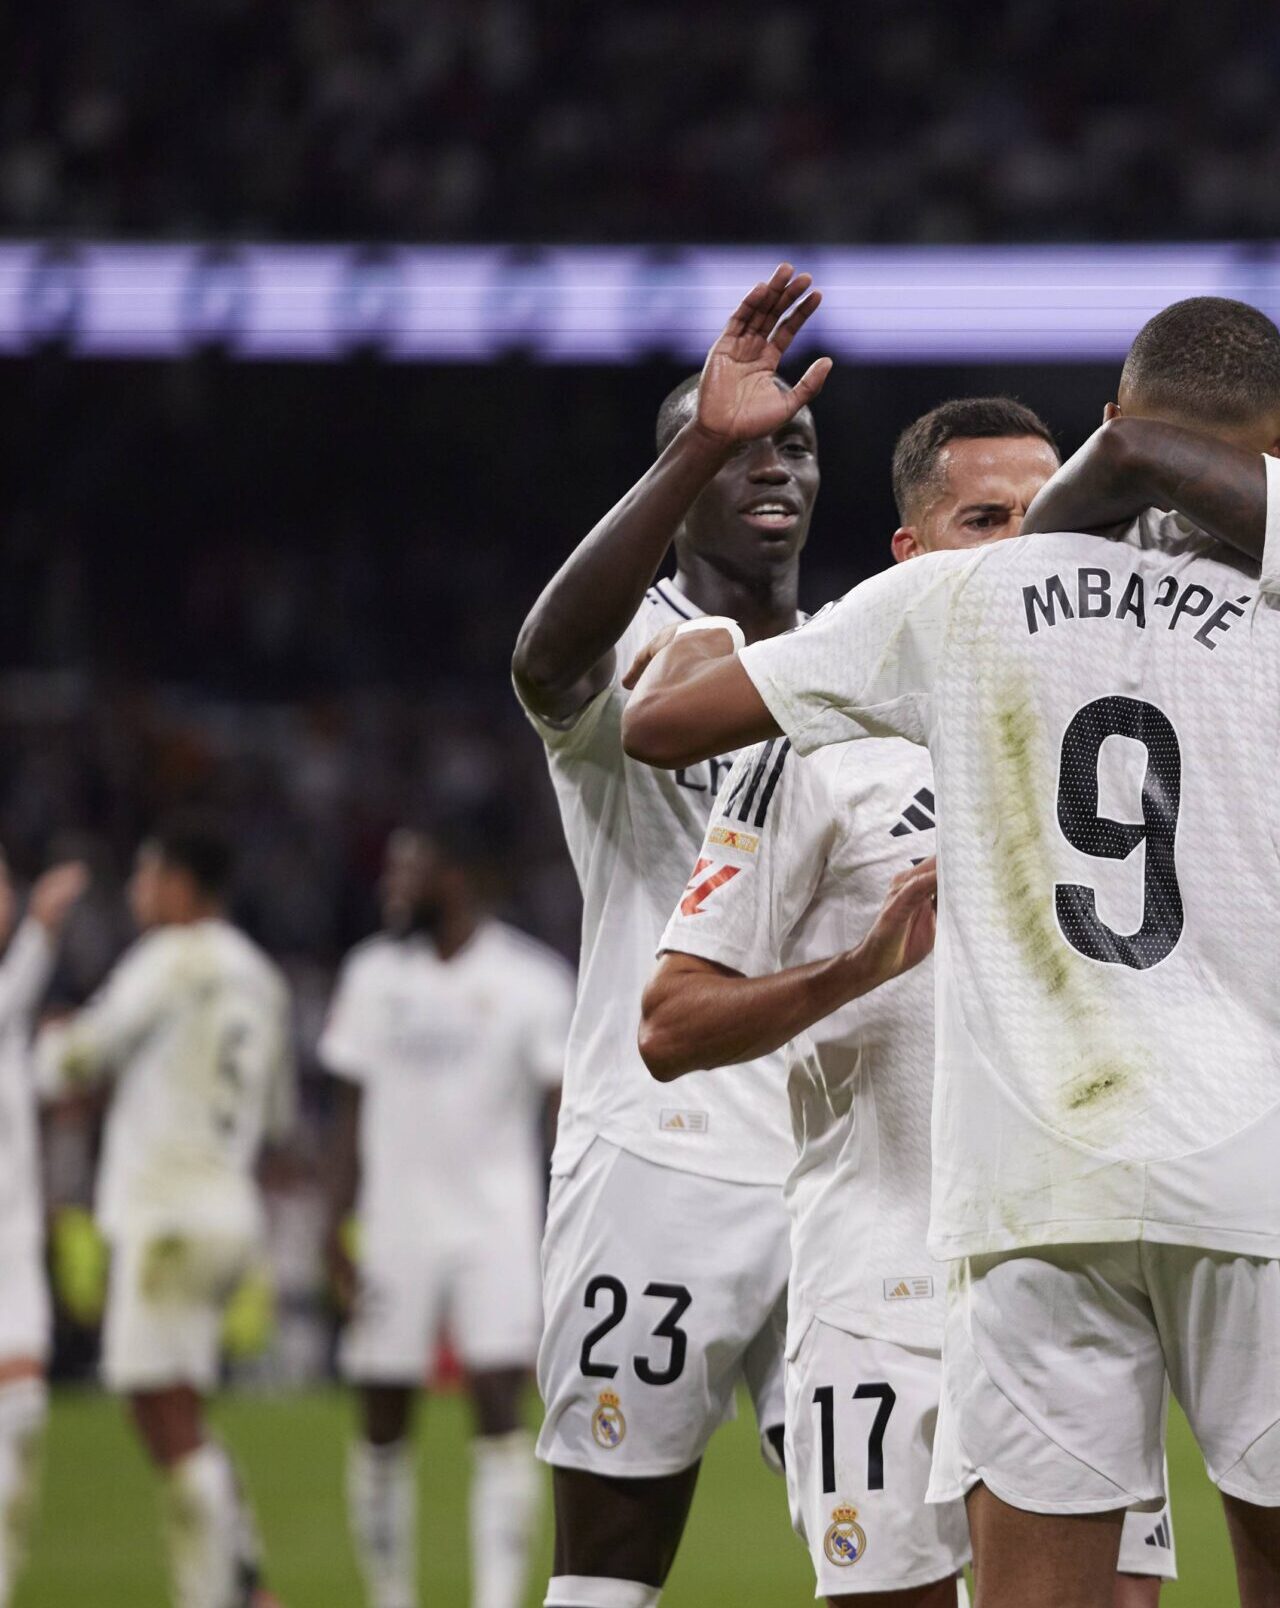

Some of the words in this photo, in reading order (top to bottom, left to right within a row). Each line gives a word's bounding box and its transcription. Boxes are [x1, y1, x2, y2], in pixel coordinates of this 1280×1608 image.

[1022, 567, 1252, 651] MBAPPÉ
[1055, 695, 1185, 971] 9
[579, 1274, 693, 1387] 23
[812, 1382, 897, 1494] 17
